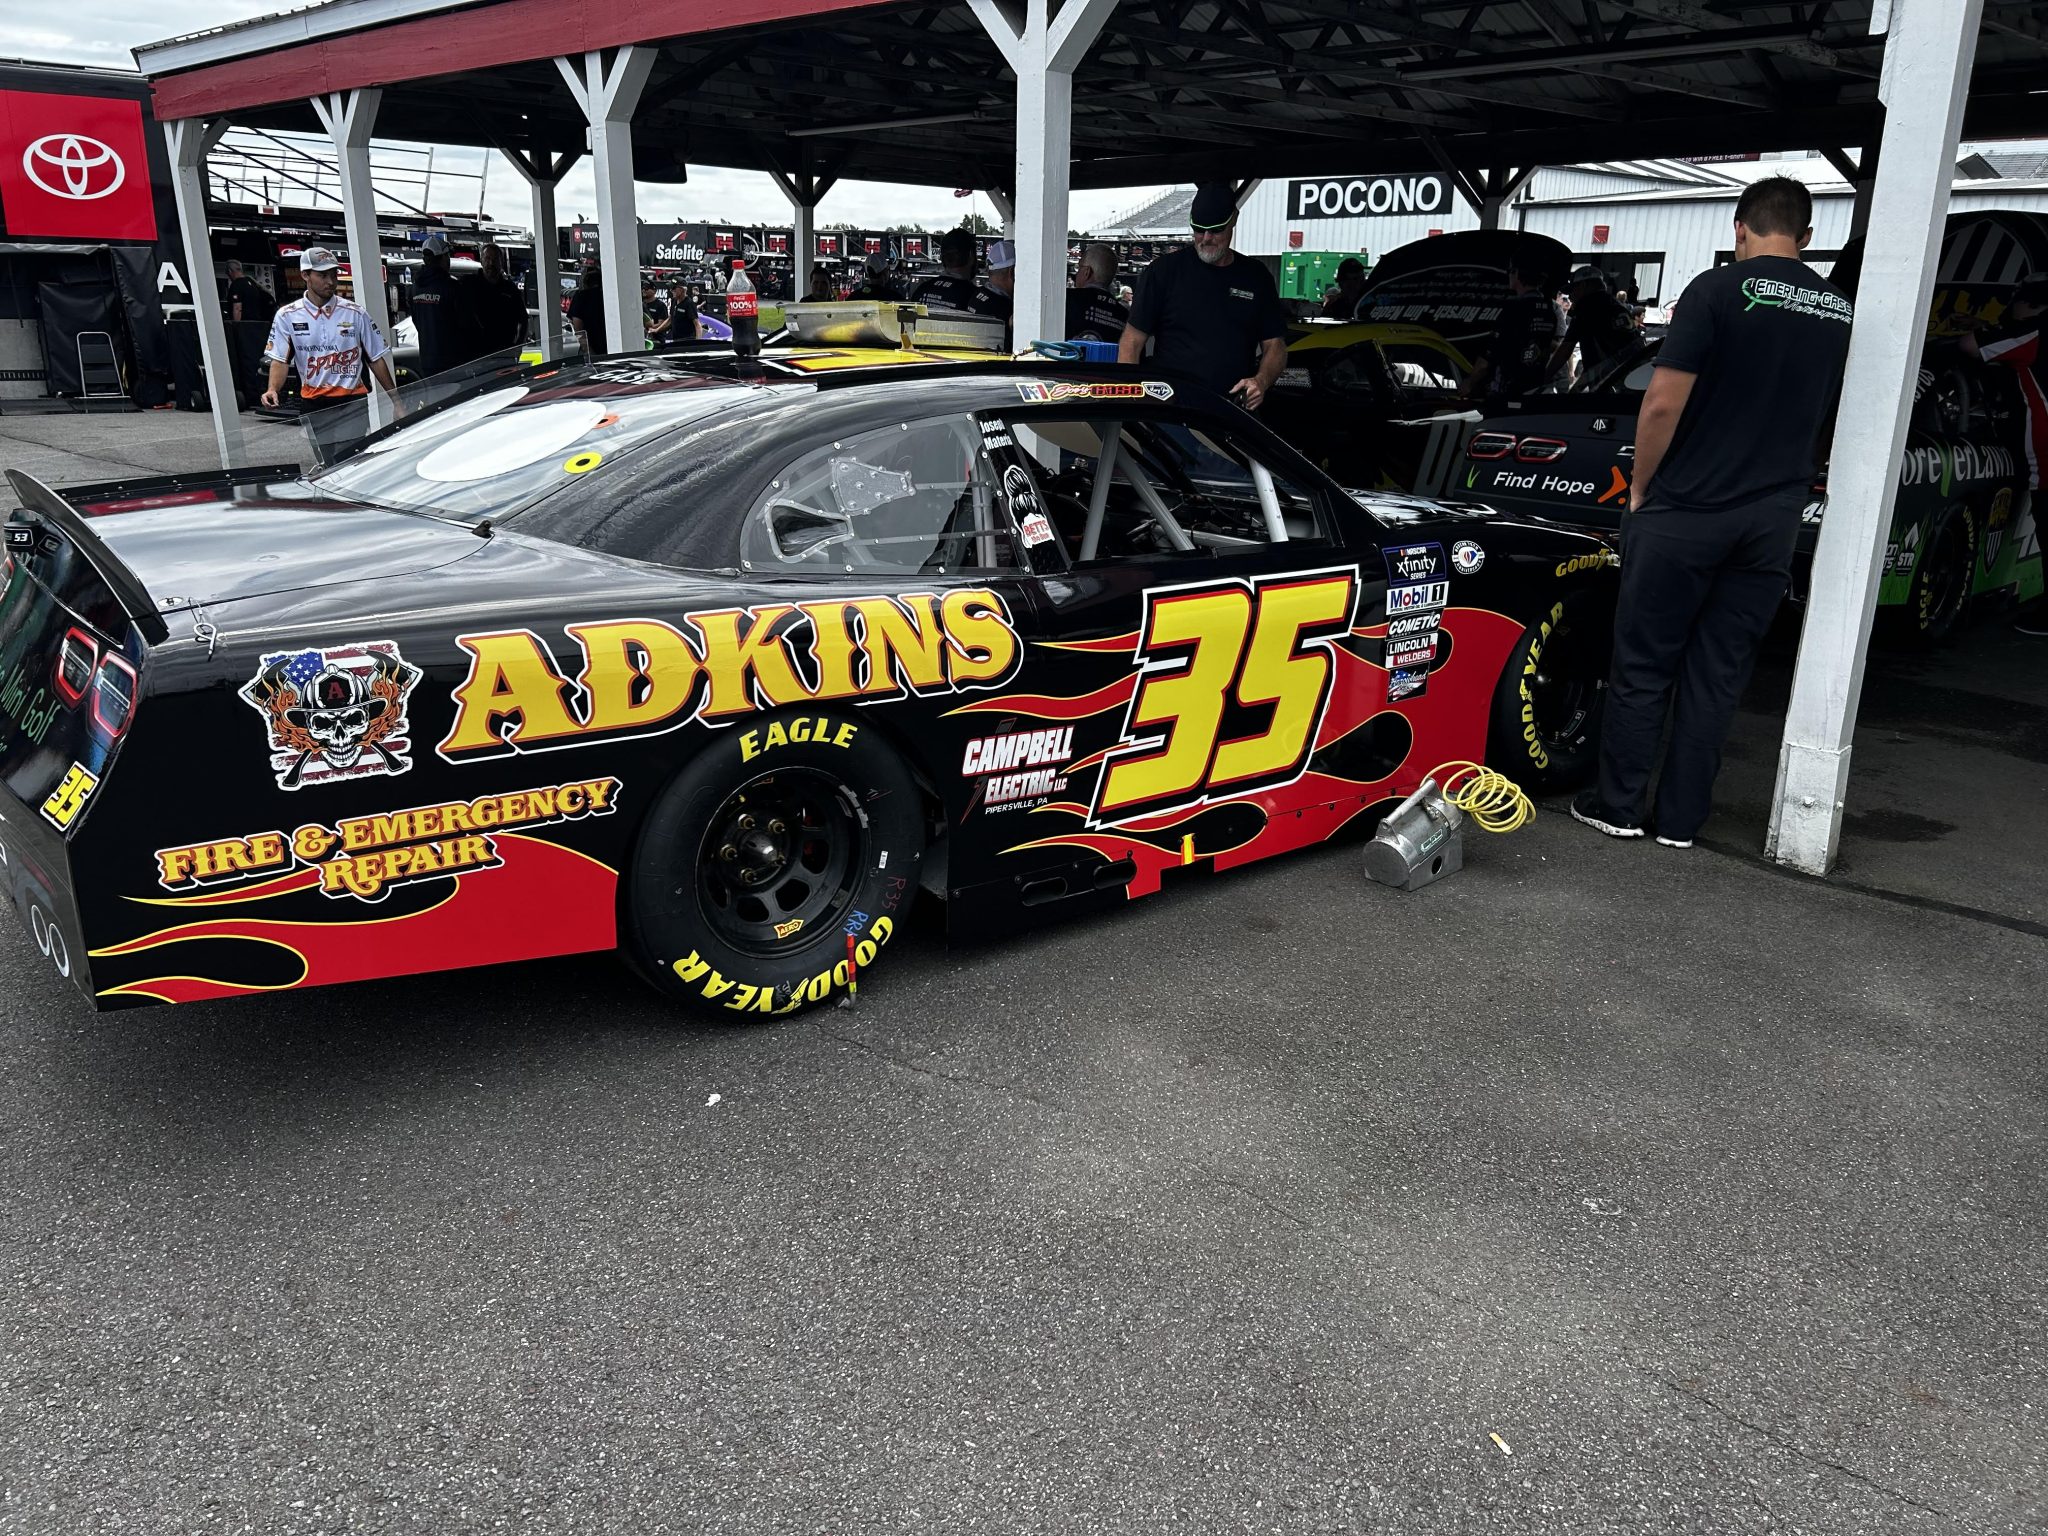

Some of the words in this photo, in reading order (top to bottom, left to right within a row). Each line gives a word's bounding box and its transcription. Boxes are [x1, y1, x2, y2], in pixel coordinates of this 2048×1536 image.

[1298, 176, 1442, 216] POCONO
[581, 231, 599, 239] TOYOTA
[656, 243, 704, 261] Safelite
[730, 301, 752, 310] 100%
[307, 346, 360, 380] SPIKED
[331, 365, 359, 375] LIGHT
[1493, 471, 1538, 489] Find
[1541, 476, 1596, 496] Hope
[14, 532, 28, 542] 53
[1023, 520, 1050, 537] BETTS
[1406, 546, 1428, 556] NASCAR
[1897, 552, 1915, 567] STR
[1396, 555, 1437, 578] xfinity
[1410, 571, 1427, 581] SERIES
[1390, 585, 1429, 610] Mobil
[1434, 585, 1442, 602] 1
[1388, 613, 1441, 635] COMETIC
[1389, 637, 1429, 655] LINCOLN
[1397, 649, 1431, 664] WELDERS
[439, 584, 1020, 759] ADKINS
[326, 681, 346, 700] A
[1092, 569, 1357, 822] 35
[1519, 601, 1563, 770] GOODYEAR
[20, 687, 62, 746] Golf
[739, 717, 858, 763] EAGLE
[962, 725, 1075, 777] CAMPBELL
[42, 762, 98, 829] 35
[984, 768, 1057, 805] ELECTRIC
[1053, 777, 1068, 792] LLC
[984, 800, 1035, 815] PIPERSVILLE,
[1037, 797, 1048, 805] PA
[159, 831, 287, 886] FIRE
[293, 825, 337, 858] &
[338, 778, 617, 853] EMERGENCY
[319, 835, 497, 896] REPAIR
[779, 922, 799, 936] AERO
[672, 915, 894, 1015] GOODYEAR
